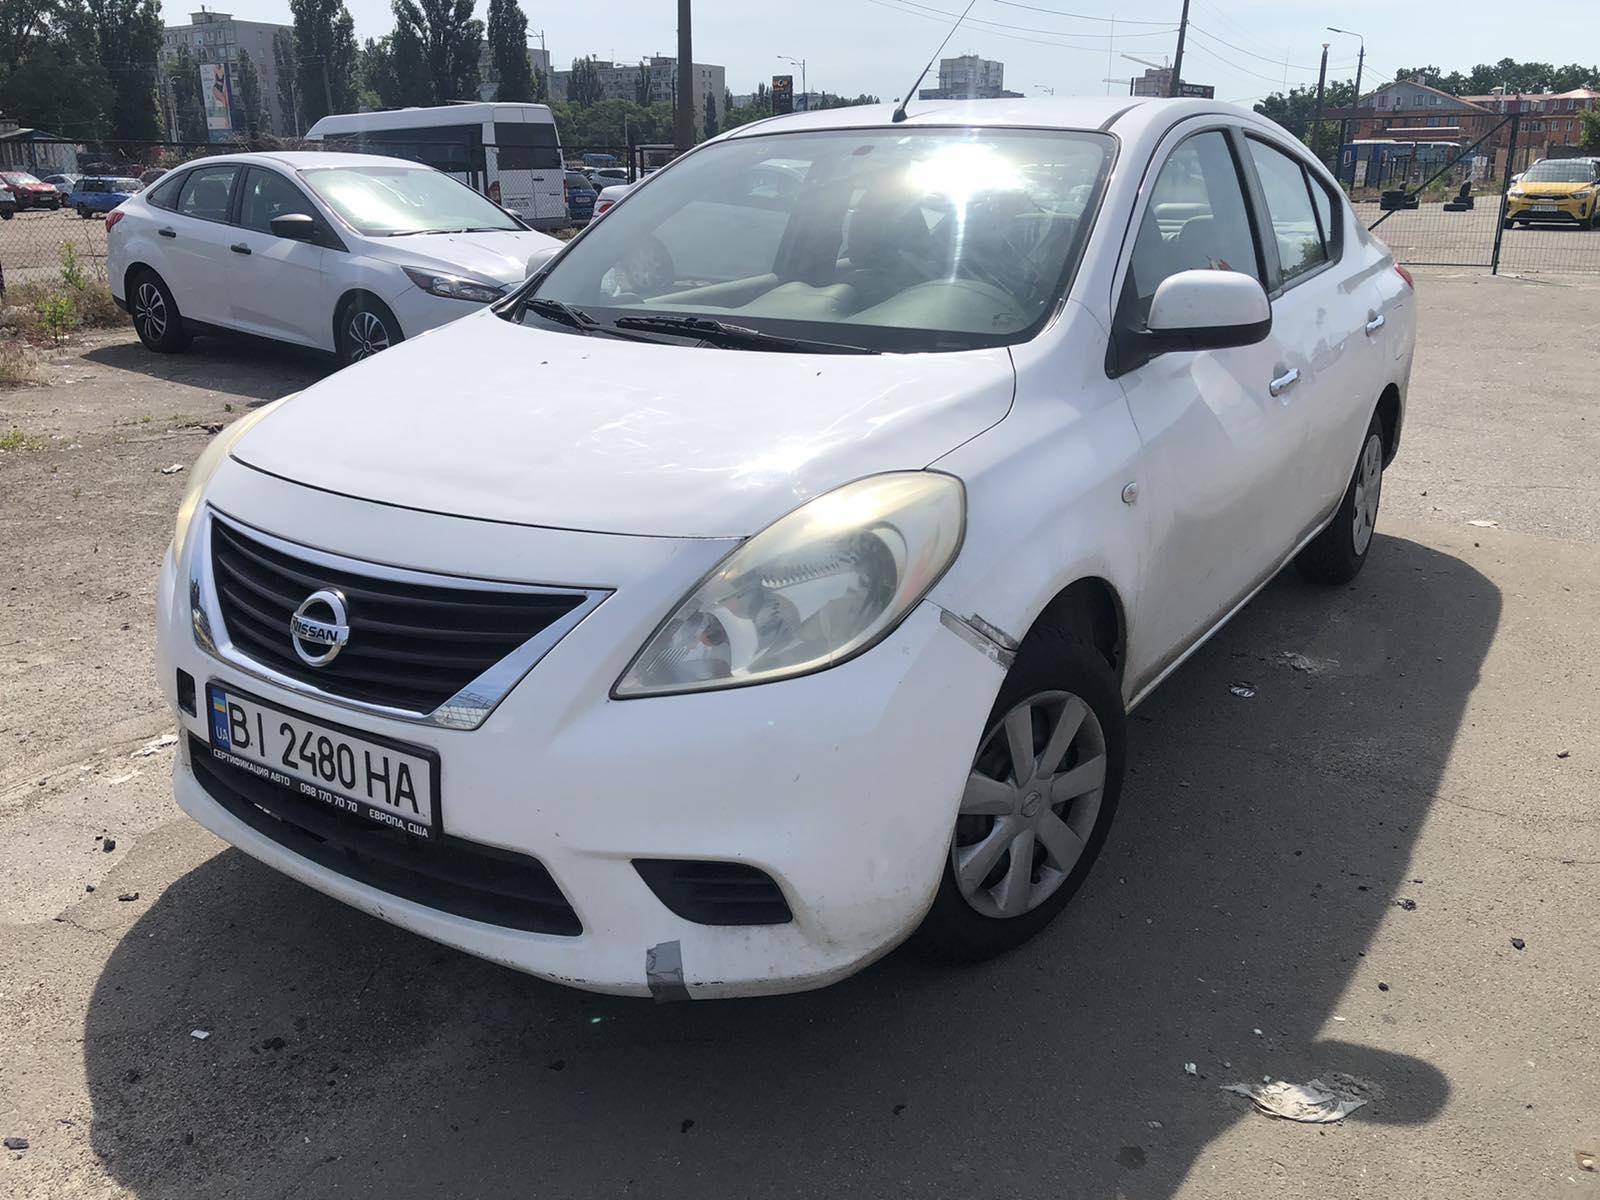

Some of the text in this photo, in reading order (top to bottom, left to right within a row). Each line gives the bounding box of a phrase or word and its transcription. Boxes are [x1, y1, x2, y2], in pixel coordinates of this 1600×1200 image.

[292, 617, 338, 642] NISSAN
[215, 726, 230, 742] UA
[213, 748, 269, 778] СЕРТИФИКАЦИЯ
[270, 772, 290, 787] АВТО
[300, 782, 317, 797] 098
[318, 789, 333, 803] 170
[333, 795, 345, 807] 70
[347, 799, 358, 813] 70
[407, 822, 429, 838] США
[279, 722, 356, 790] 2480
[364, 750, 420, 814] HA
